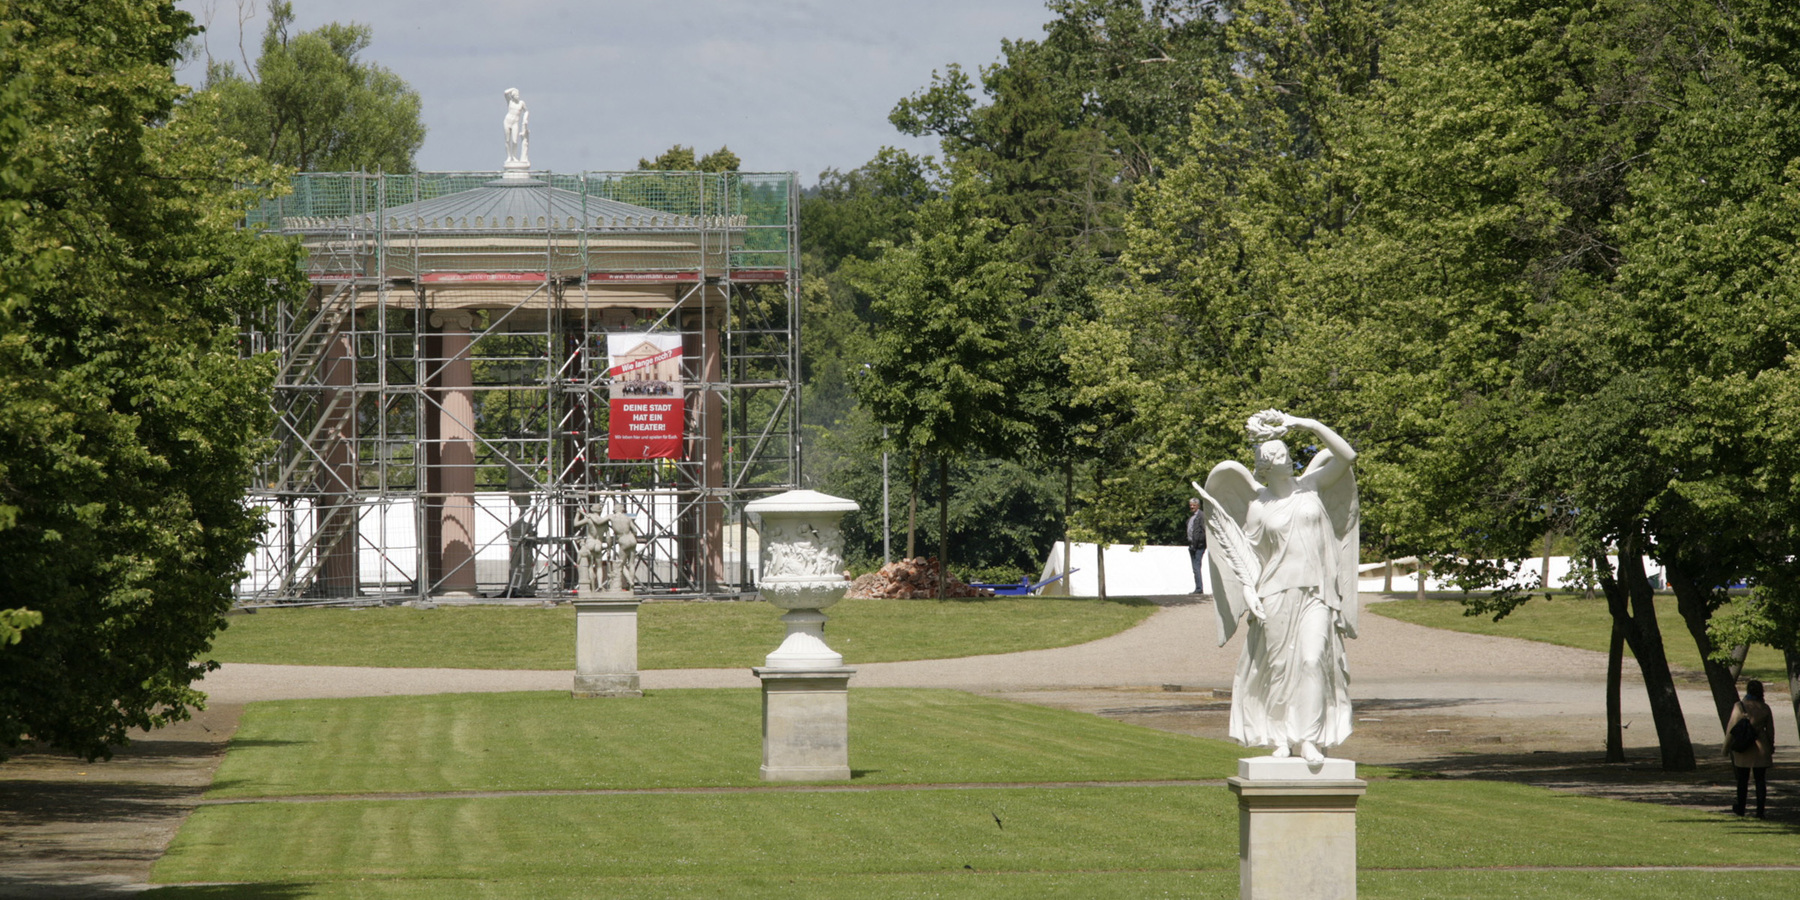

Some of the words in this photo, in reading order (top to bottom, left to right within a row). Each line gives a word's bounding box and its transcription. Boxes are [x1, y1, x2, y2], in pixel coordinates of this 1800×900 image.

[621, 363, 635, 372] Wie
[635, 357, 654, 369] lange
[654, 350, 673, 362] noch?
